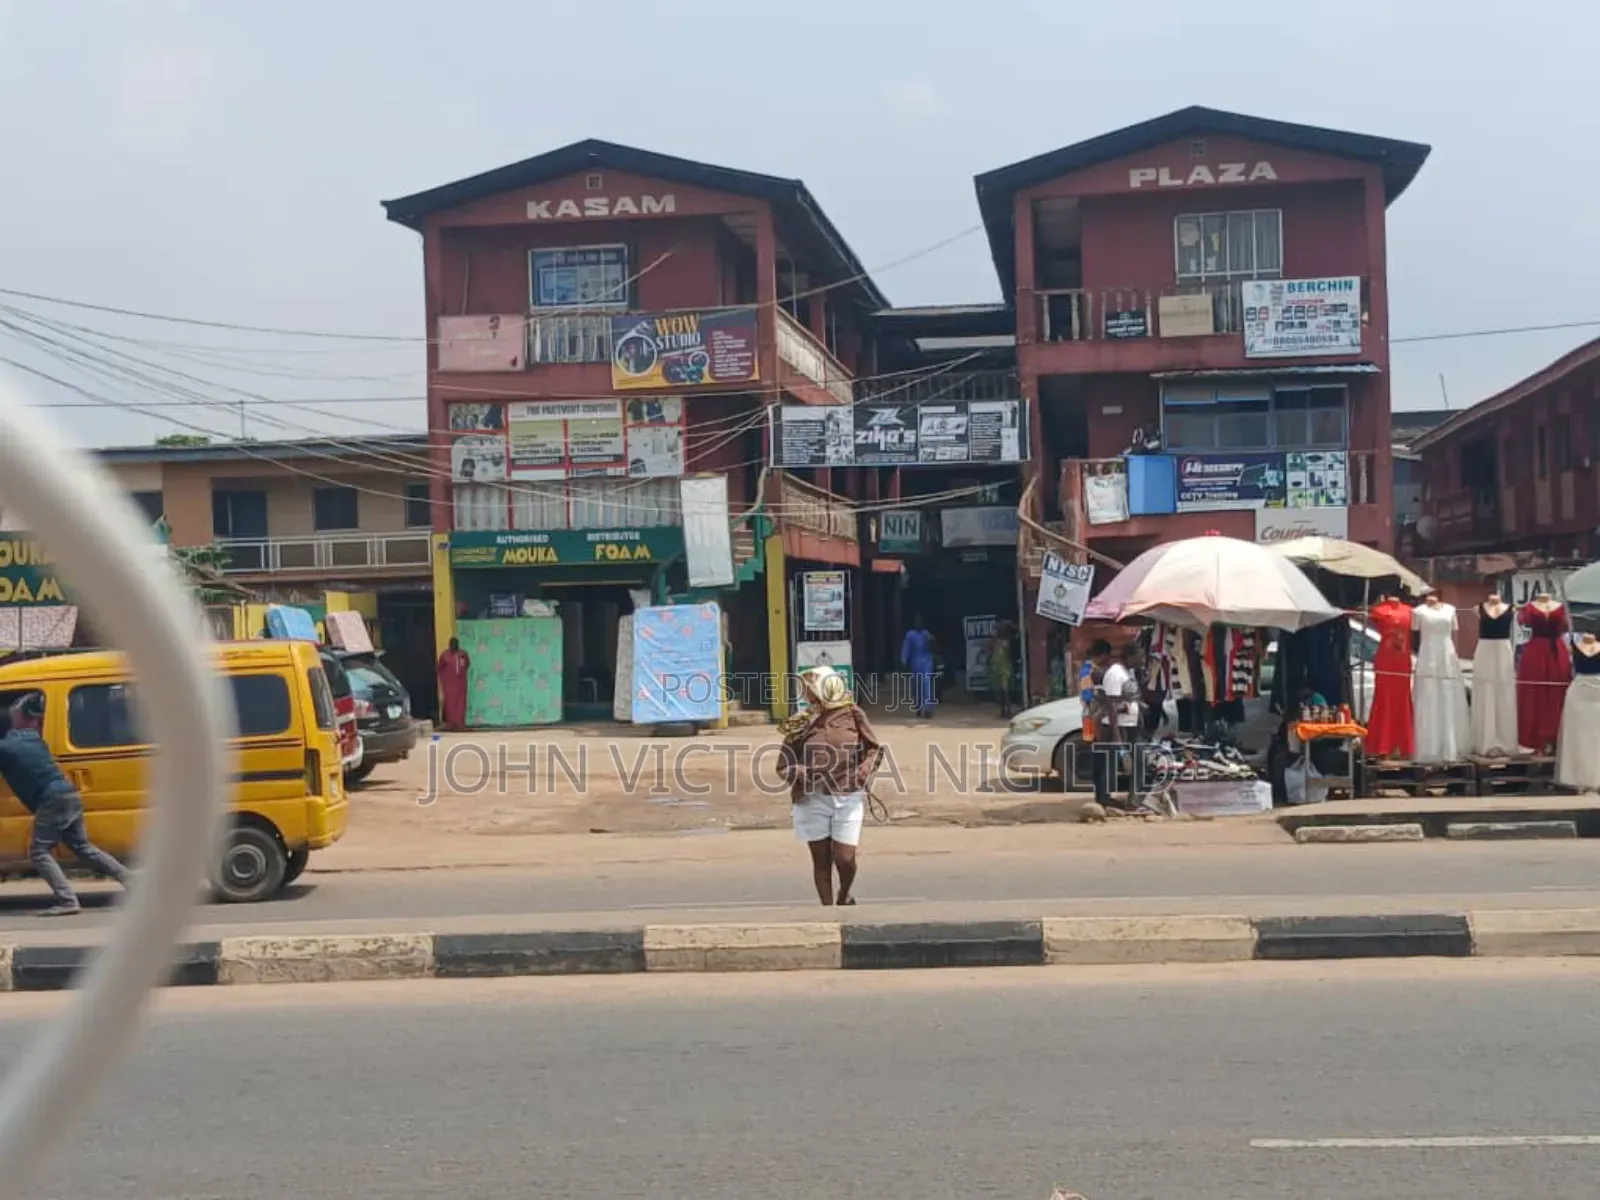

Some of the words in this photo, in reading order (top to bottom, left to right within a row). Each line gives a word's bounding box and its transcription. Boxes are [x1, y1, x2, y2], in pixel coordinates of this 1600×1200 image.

[1128, 161, 1278, 188] PLAZA
[526, 193, 676, 219] KASAM
[655, 314, 699, 335] WOW
[656, 332, 701, 350] STUDIO
[885, 516, 917, 537] NIN
[502, 547, 558, 563] MOUKA
[595, 544, 651, 561] FOAM
[1046, 556, 1089, 582] NYSC
[0, 576, 65, 601] OAM
